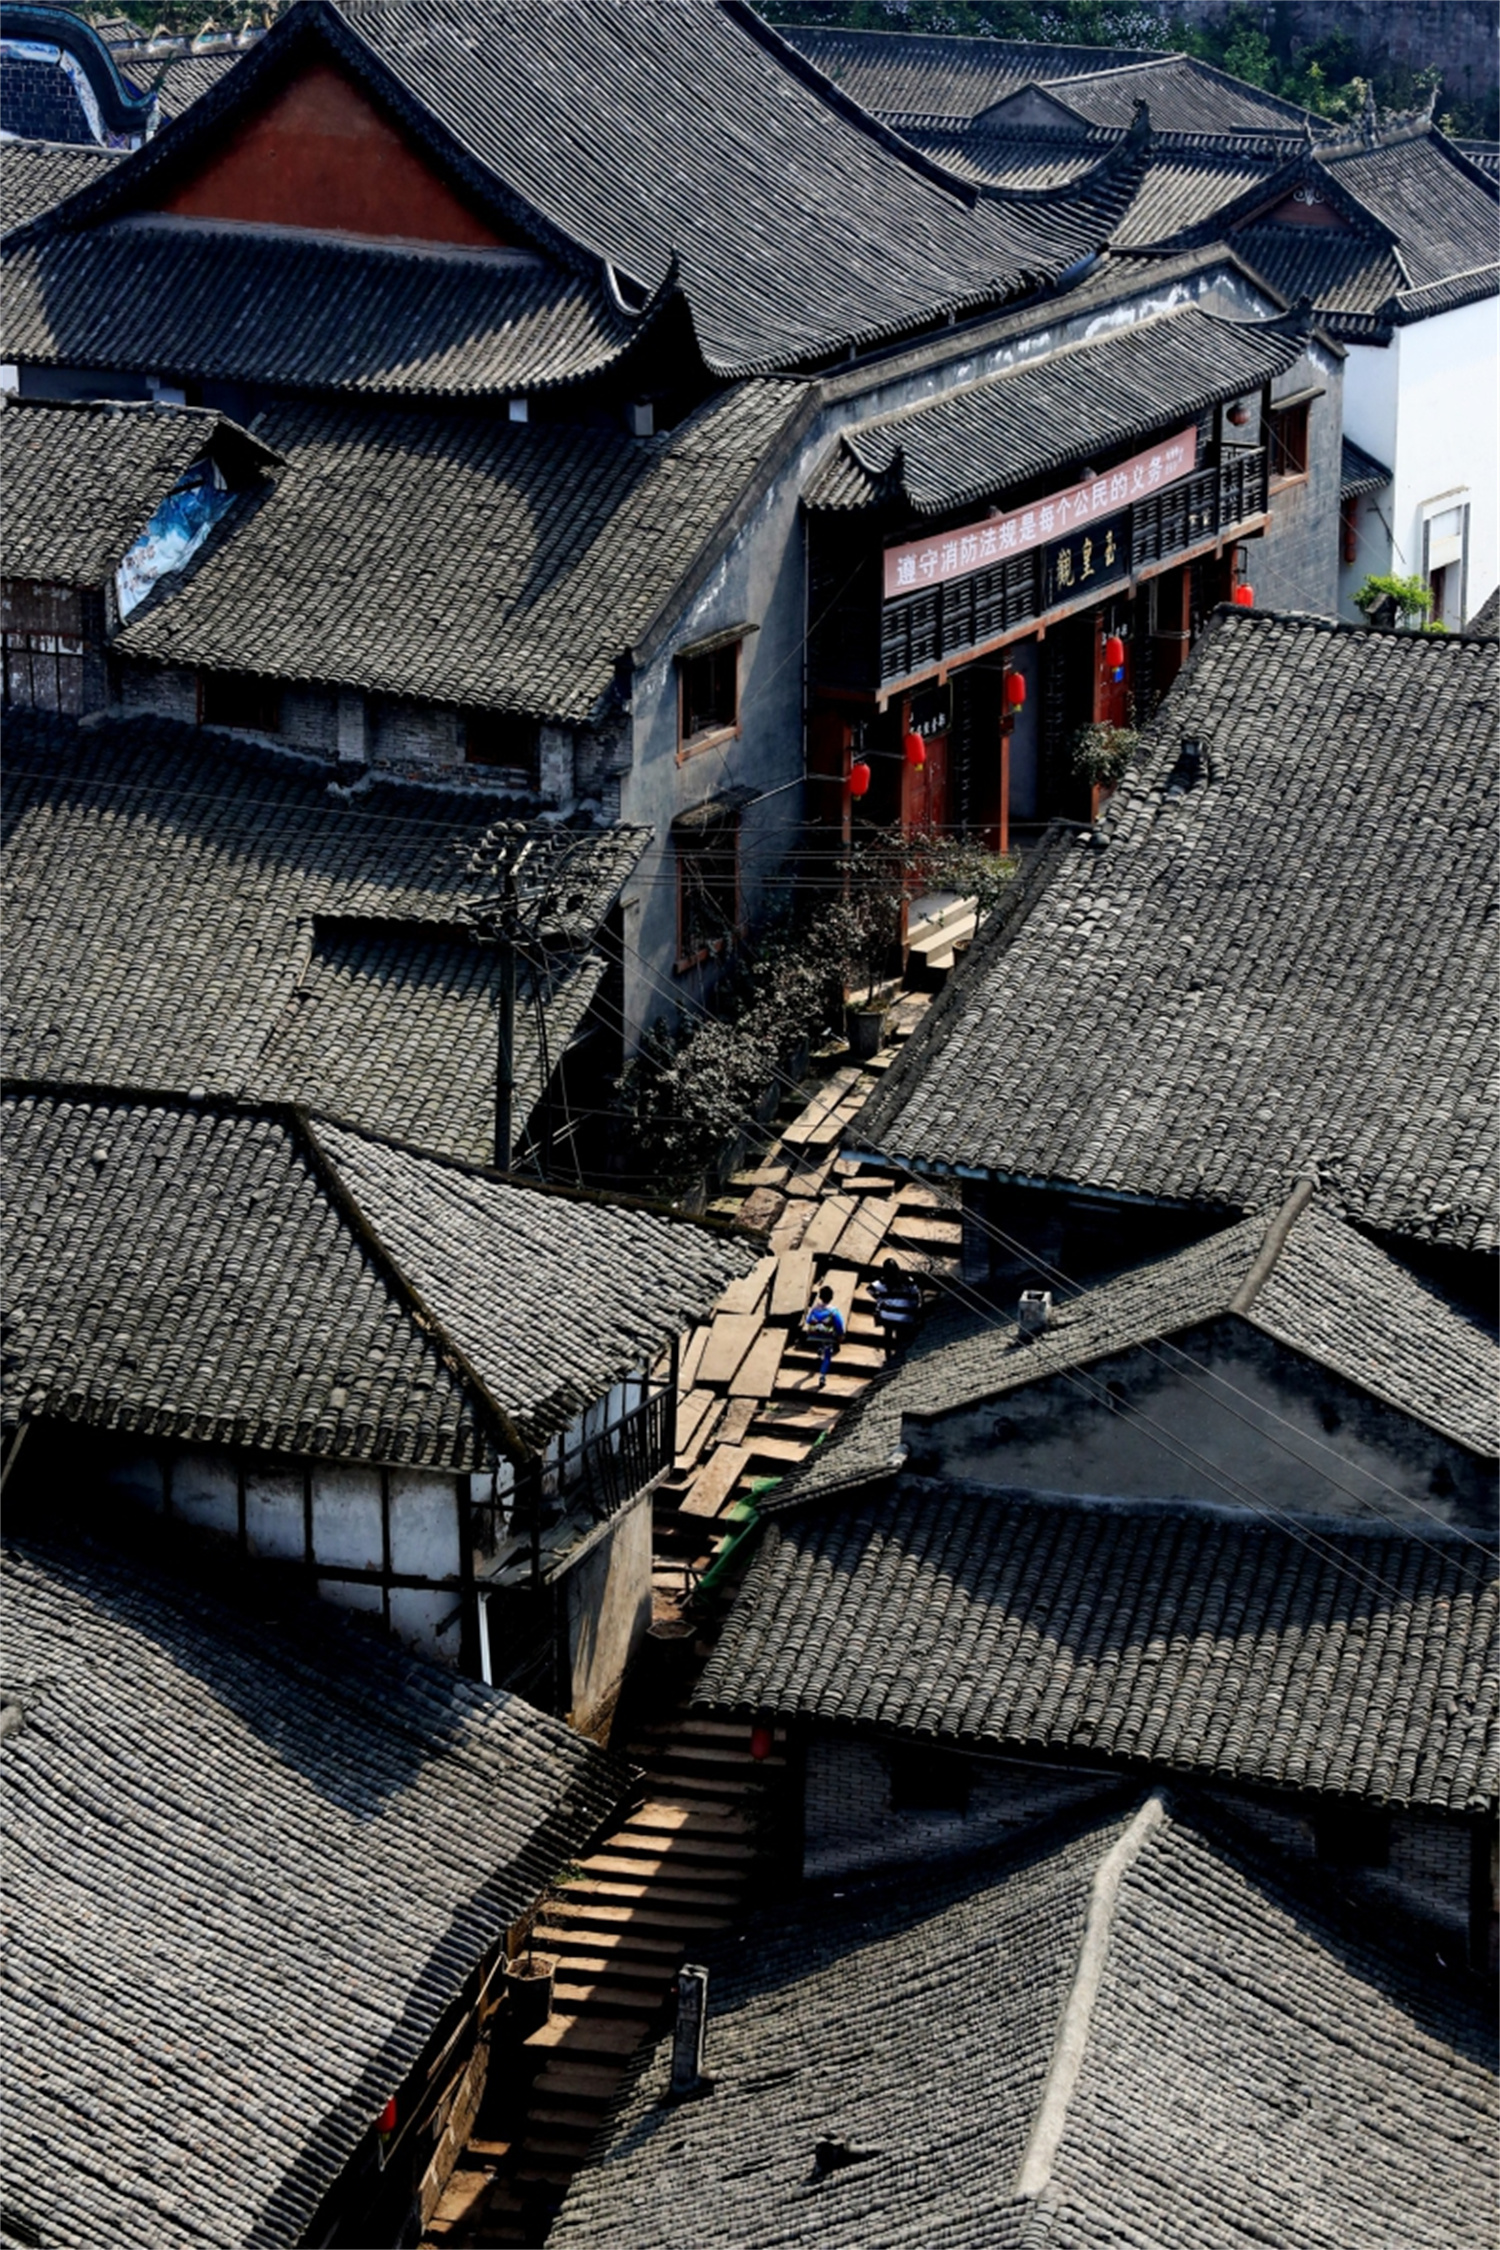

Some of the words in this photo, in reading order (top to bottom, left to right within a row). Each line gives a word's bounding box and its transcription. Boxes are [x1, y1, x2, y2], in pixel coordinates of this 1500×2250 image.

[896, 455, 1163, 586] 遵守消防法规是每个公民的义务
